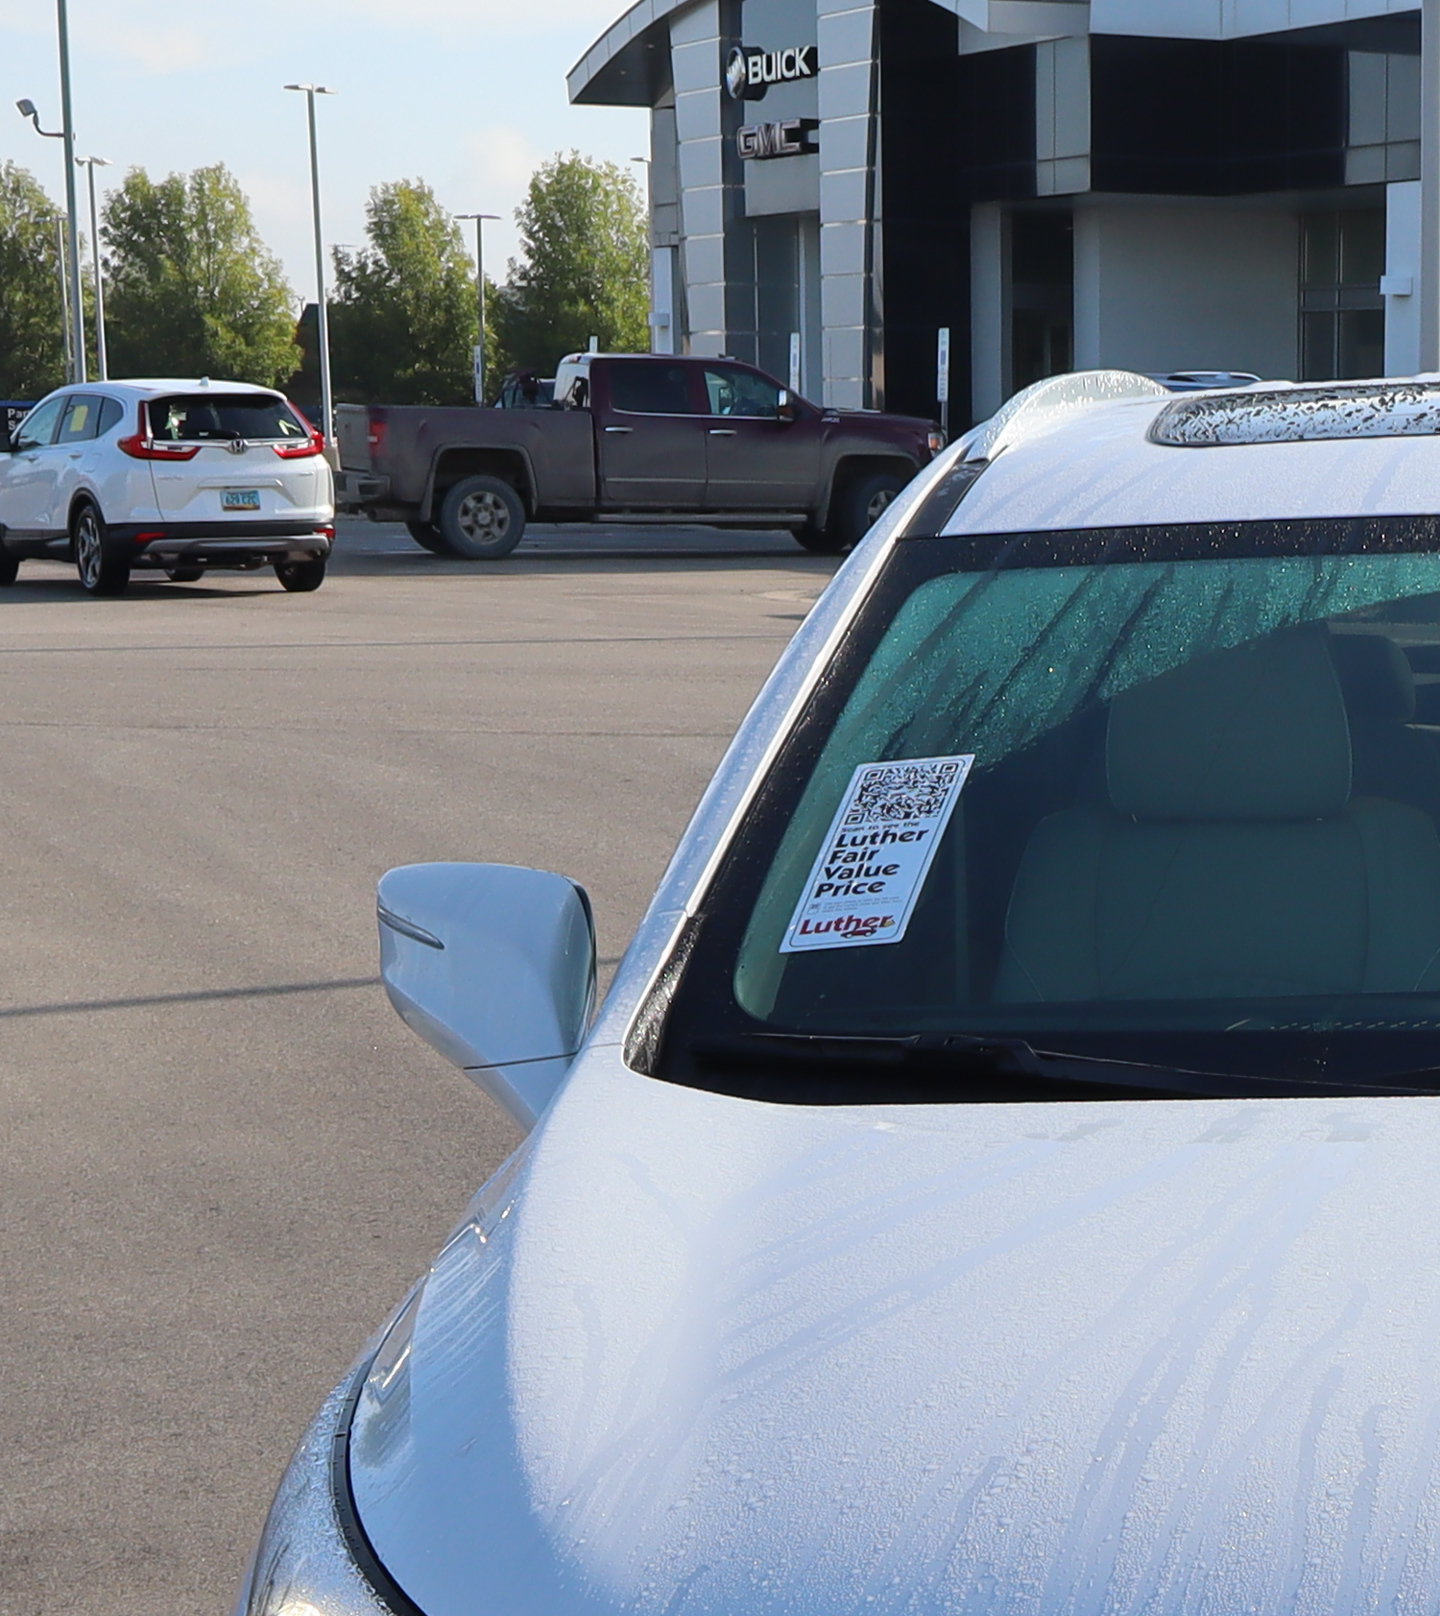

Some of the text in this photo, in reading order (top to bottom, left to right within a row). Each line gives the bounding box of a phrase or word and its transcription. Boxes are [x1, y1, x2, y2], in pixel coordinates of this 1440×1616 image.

[748, 45, 811, 84] BUICK
[737, 119, 801, 158] GMC
[835, 828, 930, 848] Luther
[828, 847, 881, 865] Fair
[823, 863, 901, 880] Value
[814, 880, 886, 899] Price
[799, 915, 894, 935] Luther
